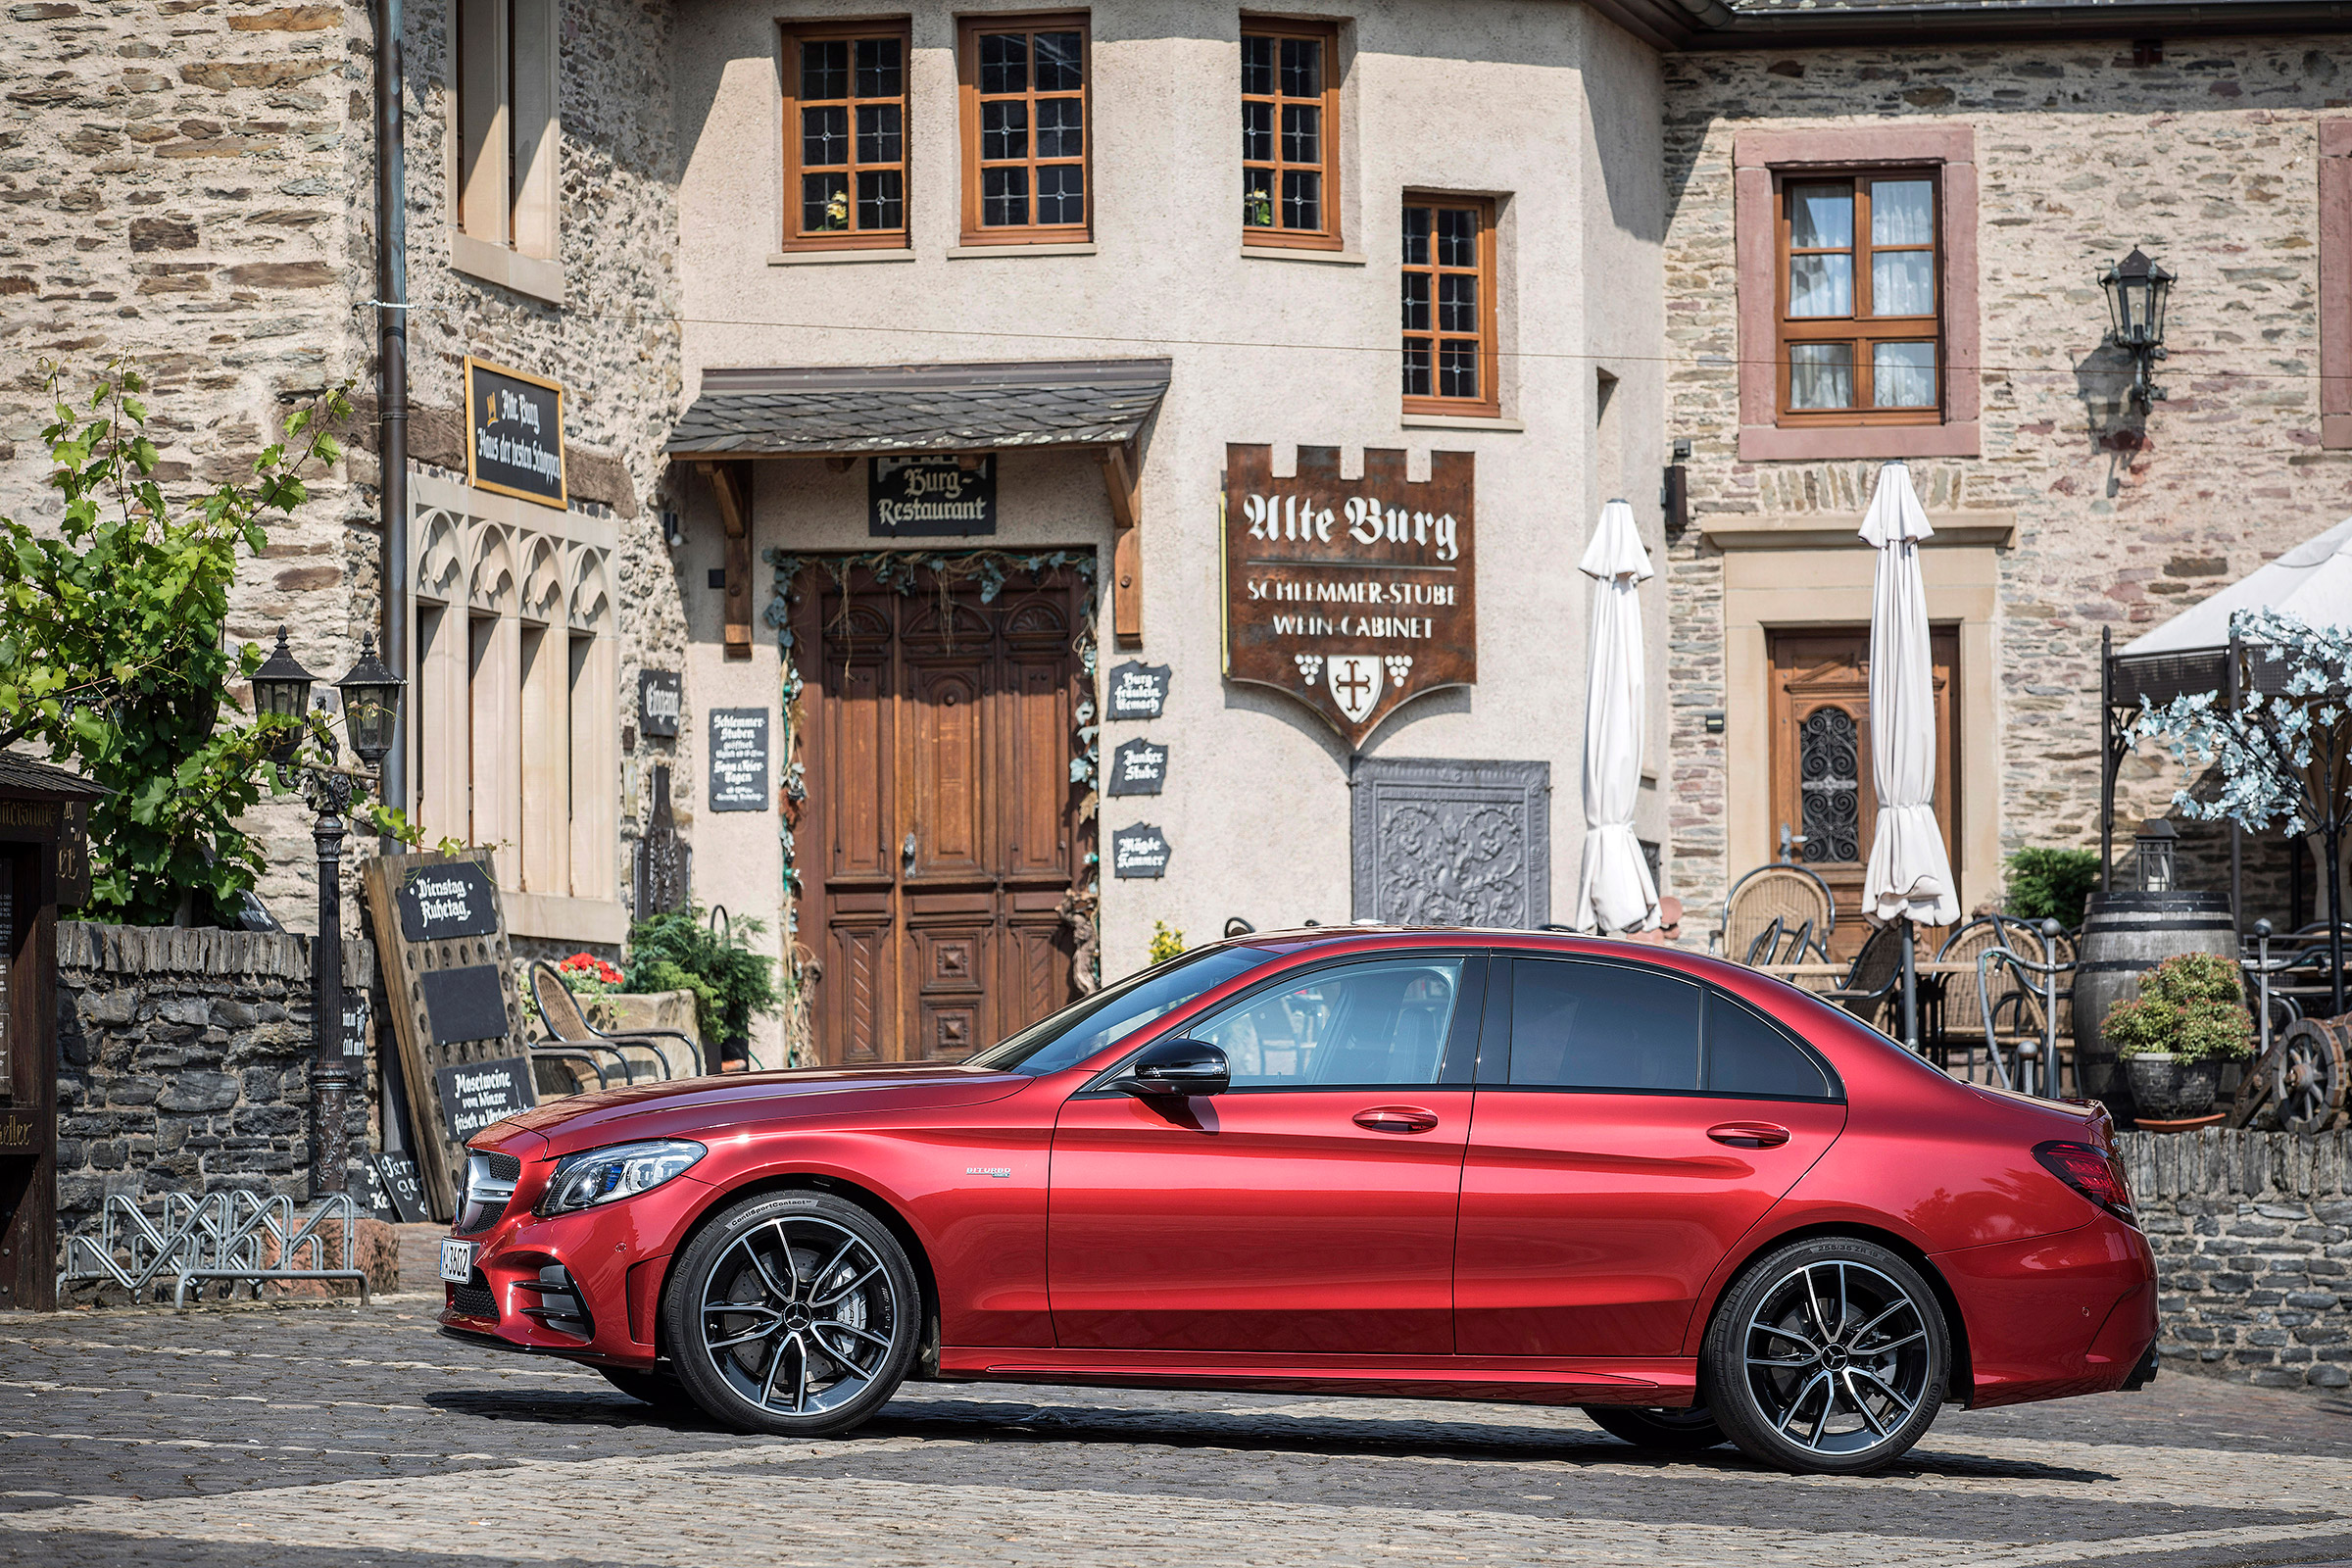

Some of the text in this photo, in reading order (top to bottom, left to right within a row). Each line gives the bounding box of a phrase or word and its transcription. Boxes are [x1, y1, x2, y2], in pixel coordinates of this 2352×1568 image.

[501, 389, 541, 435] Alte Burg
[477, 427, 499, 462] Haus
[500, 432, 511, 464] der
[512, 436, 532, 470] besten
[903, 467, 973, 499] Burg-
[877, 495, 988, 526] Restaurant
[1243, 494, 1459, 562] Alte Burg
[1247, 579, 1458, 607] SCHLEMMER-STUBE
[646, 680, 679, 726] Eingang
[720, 727, 756, 741] Stuben
[724, 771, 753, 785] Tagen
[1124, 763, 1159, 782] Stube
[416, 877, 467, 900] Dienstag
[420, 899, 472, 928] Ruhetag
[454, 1068, 512, 1099] Moselweine
[463, 1091, 507, 1108] vom Winzer
[0, 1114, 33, 1146] eller
[454, 1110, 478, 1135] frisch
